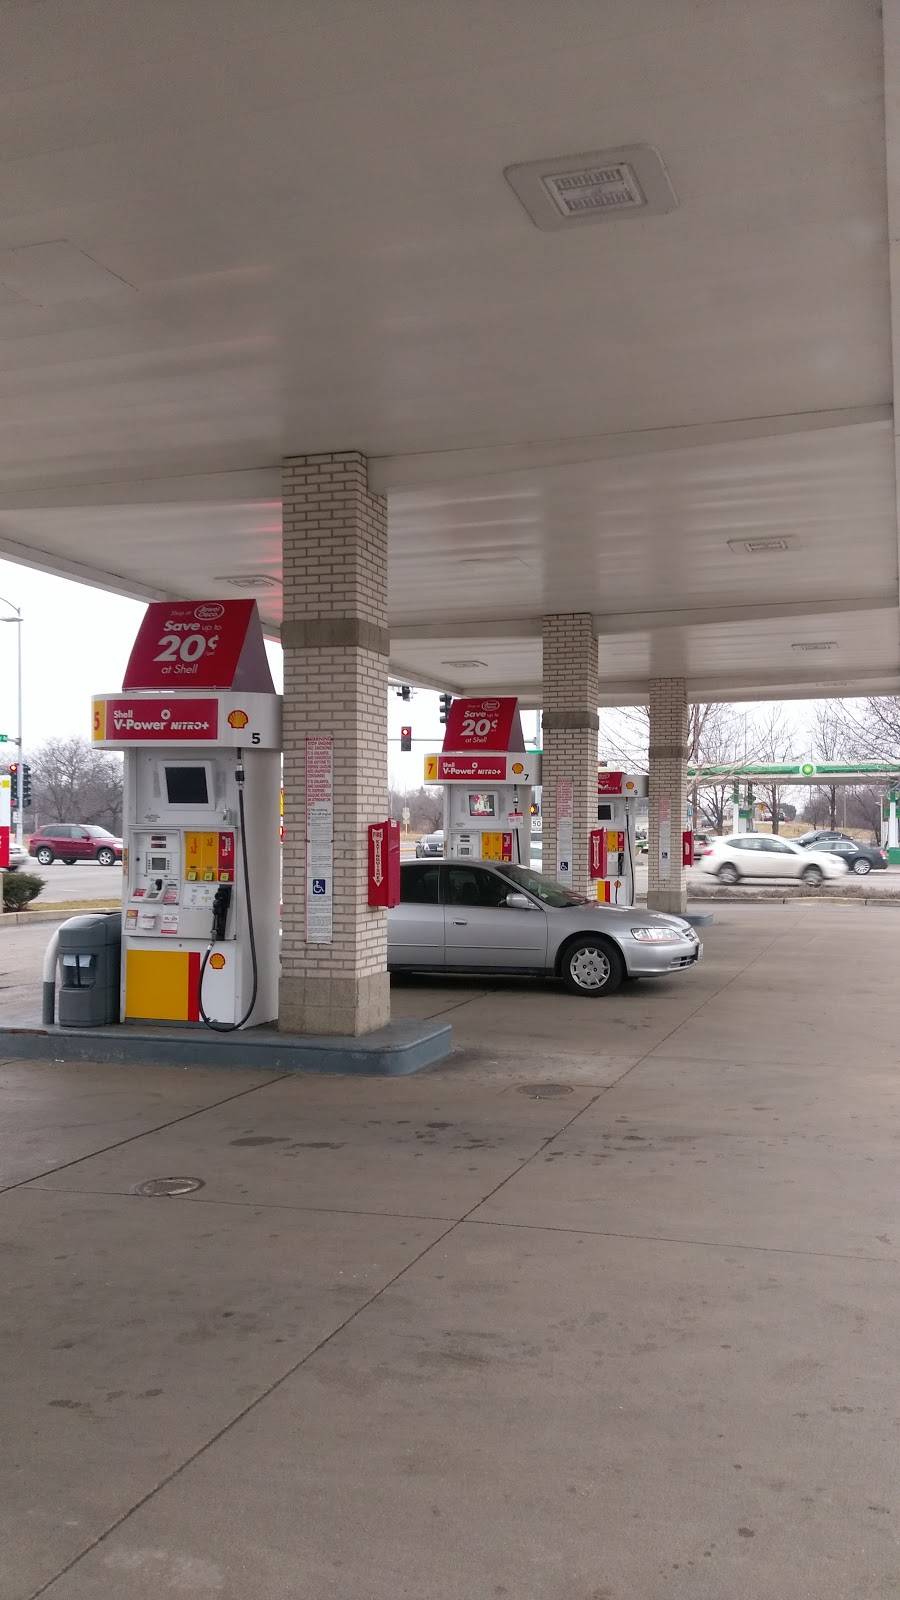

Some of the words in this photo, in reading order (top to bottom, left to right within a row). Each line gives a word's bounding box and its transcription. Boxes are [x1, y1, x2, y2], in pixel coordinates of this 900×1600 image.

[163, 620, 201, 632] Save
[161, 666, 171, 674] at
[173, 663, 198, 674] Shell
[113, 709, 133, 719] Shell
[463, 710, 486, 719] Save
[94, 711, 100, 731] 5
[113, 719, 166, 731] V-Power
[251, 732, 261, 745] 5
[427, 763, 434, 775] 7
[442, 767, 476, 775] V-Power
[524, 773, 530, 781] 7
